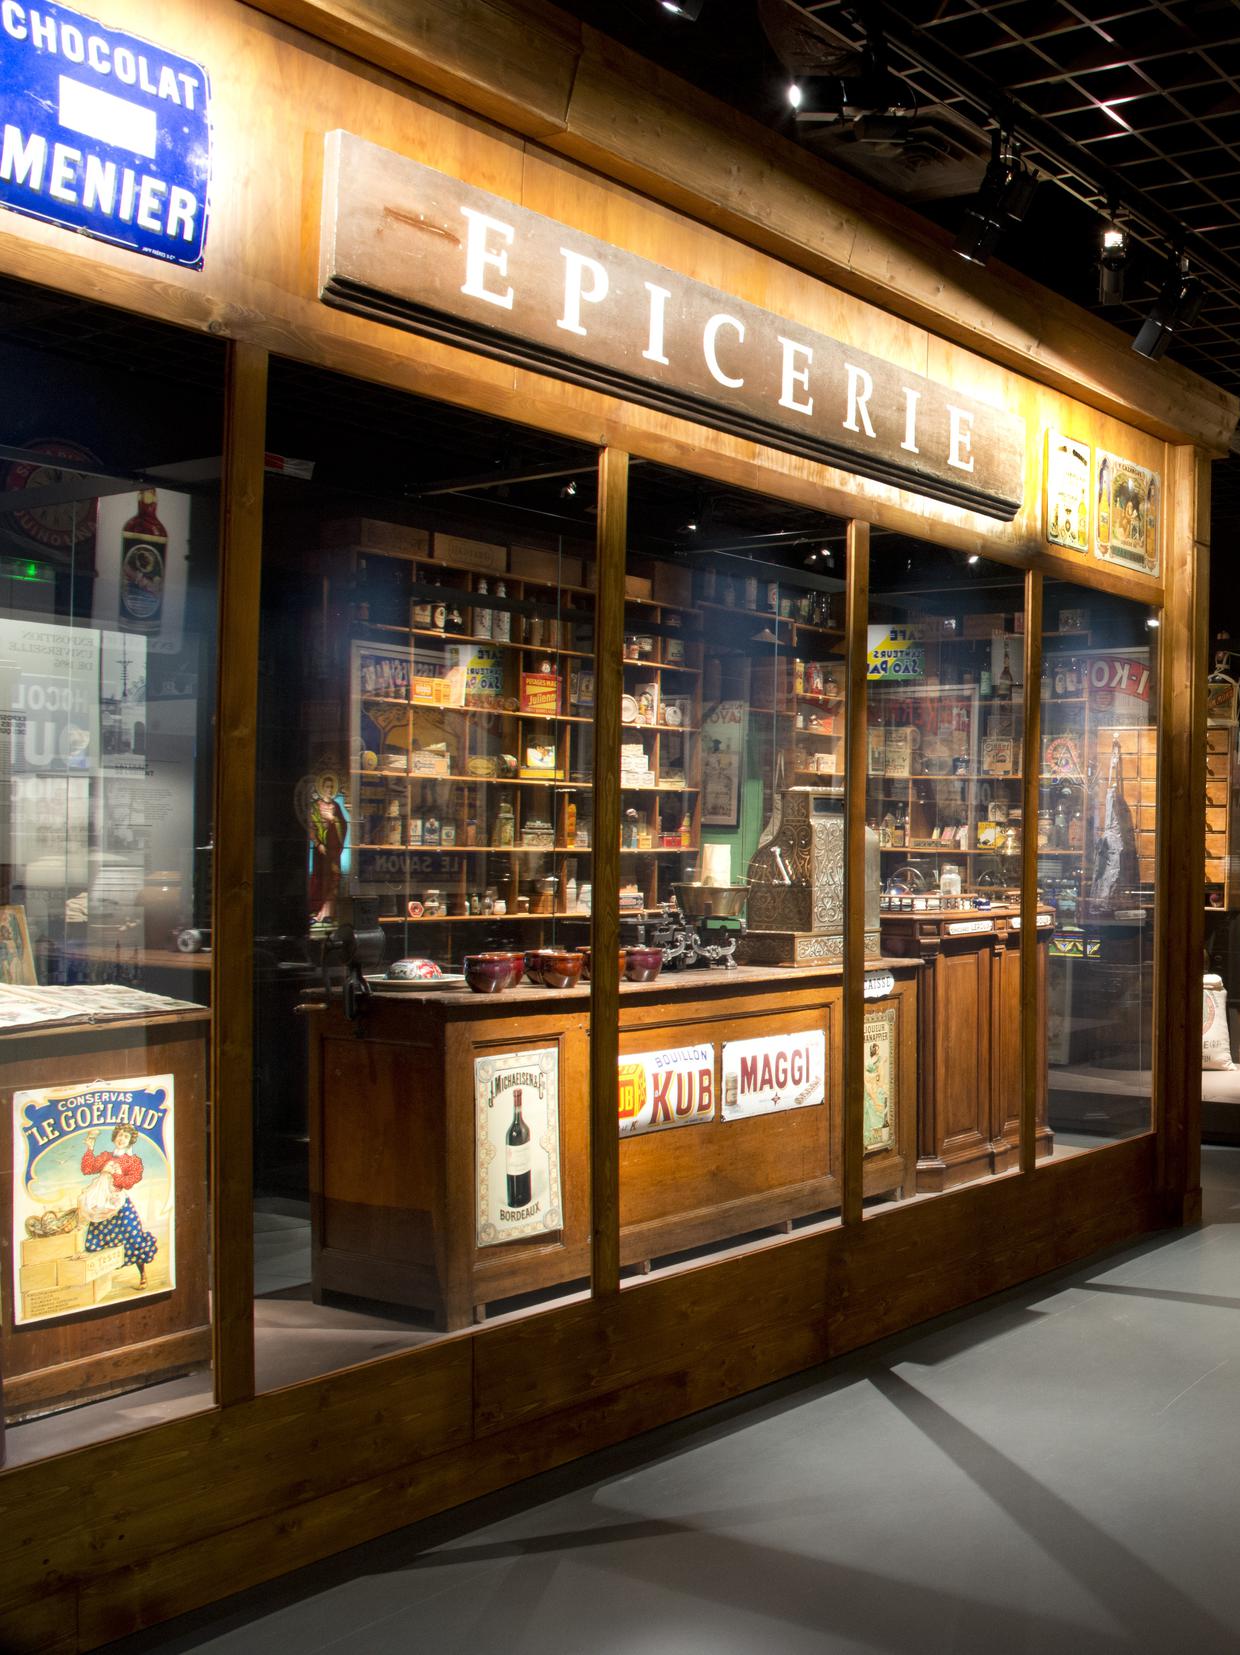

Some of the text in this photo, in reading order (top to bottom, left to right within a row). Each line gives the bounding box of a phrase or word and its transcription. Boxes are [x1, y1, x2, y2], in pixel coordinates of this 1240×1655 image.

[2, 0, 200, 111] CHOCOLAT
[0, 124, 198, 242] MENIER
[459, 206, 976, 473] EPICERIE
[654, 1049, 708, 1069] BOUILLON
[740, 1047, 810, 1095] MAGGI
[57, 1092, 134, 1111] CONSERVAS
[648, 1068, 713, 1125] KUB
[500, 1202, 541, 1222] BORDEAUX
